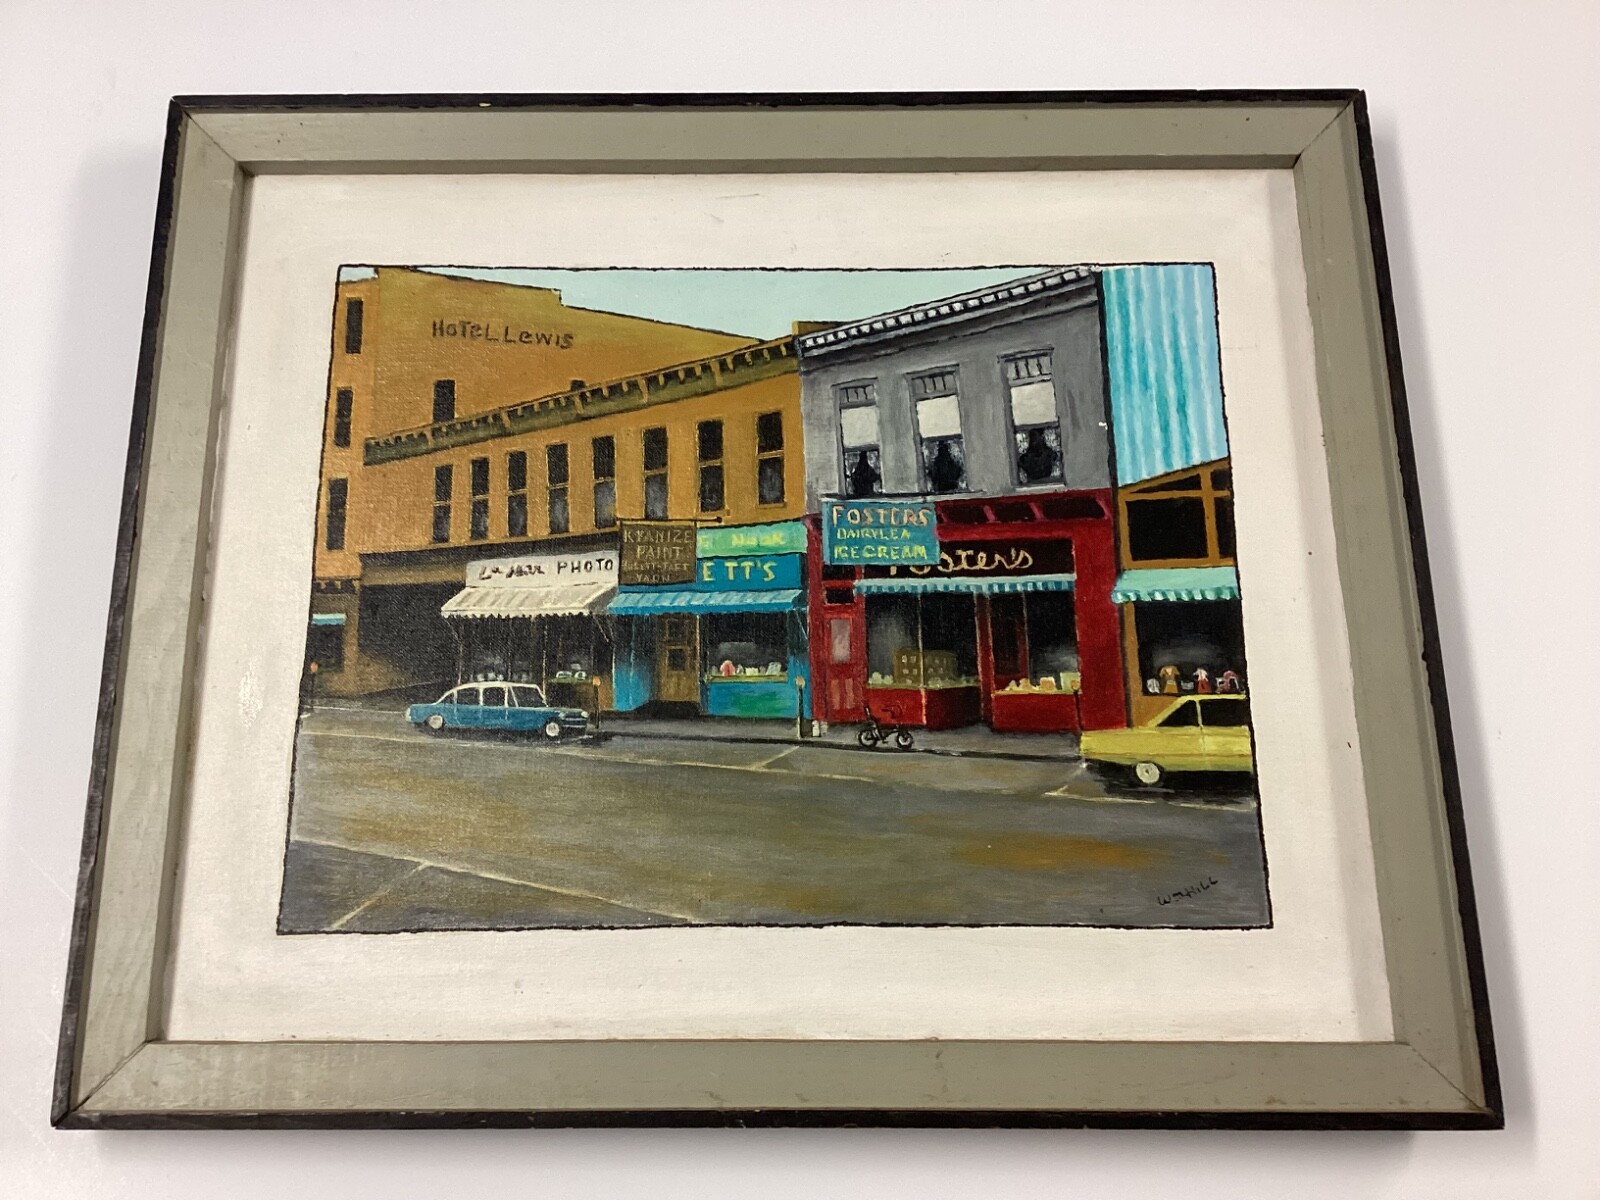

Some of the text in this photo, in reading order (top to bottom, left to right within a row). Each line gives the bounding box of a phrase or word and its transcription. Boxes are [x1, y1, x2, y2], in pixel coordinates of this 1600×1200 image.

[636, 545, 684, 560] PAINT
[862, 545, 928, 560] CREAM
[557, 558, 614, 575] PHOTO
